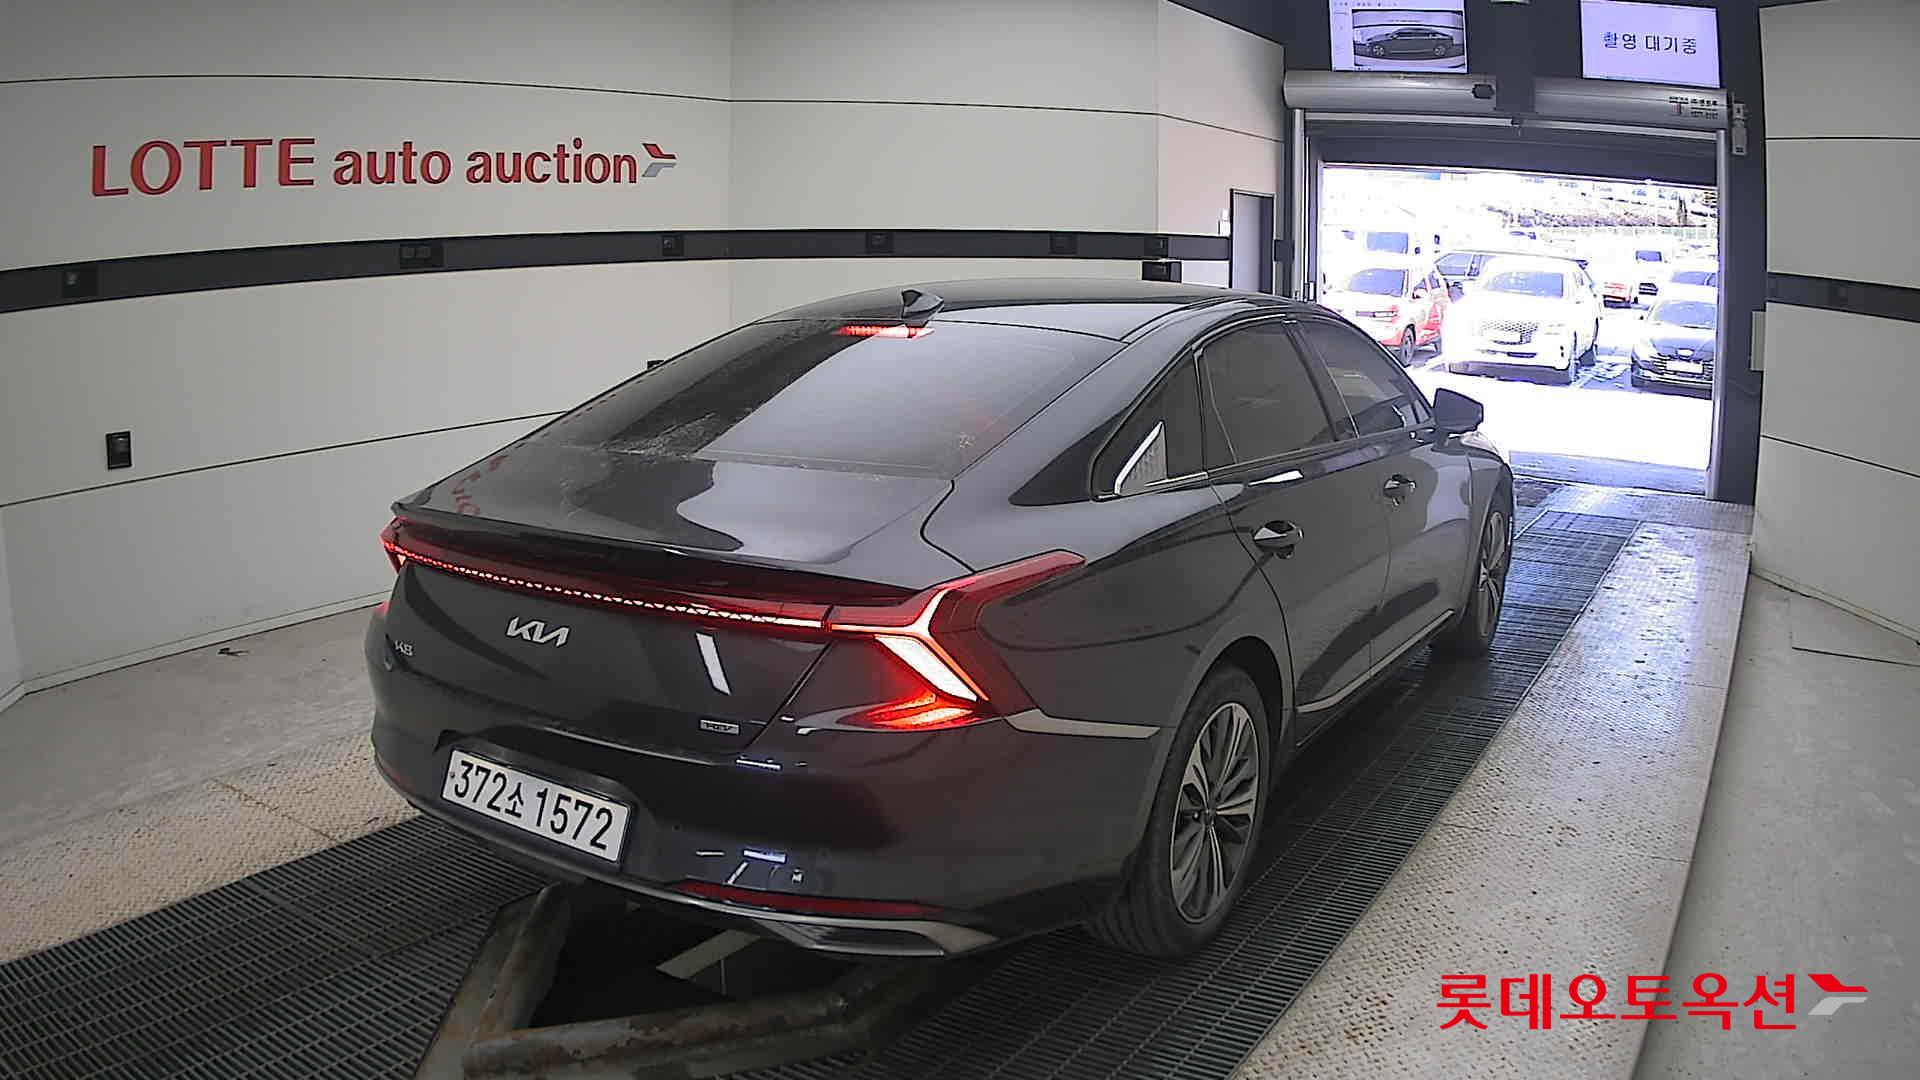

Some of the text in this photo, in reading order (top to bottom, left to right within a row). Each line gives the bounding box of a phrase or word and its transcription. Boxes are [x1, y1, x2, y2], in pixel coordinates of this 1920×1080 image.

[1645, 34, 1697, 55] 대기중
[92, 138, 638, 196] LOTTE auto auction
[506, 616, 571, 647] KIA
[535, 787, 613, 850] 1572
